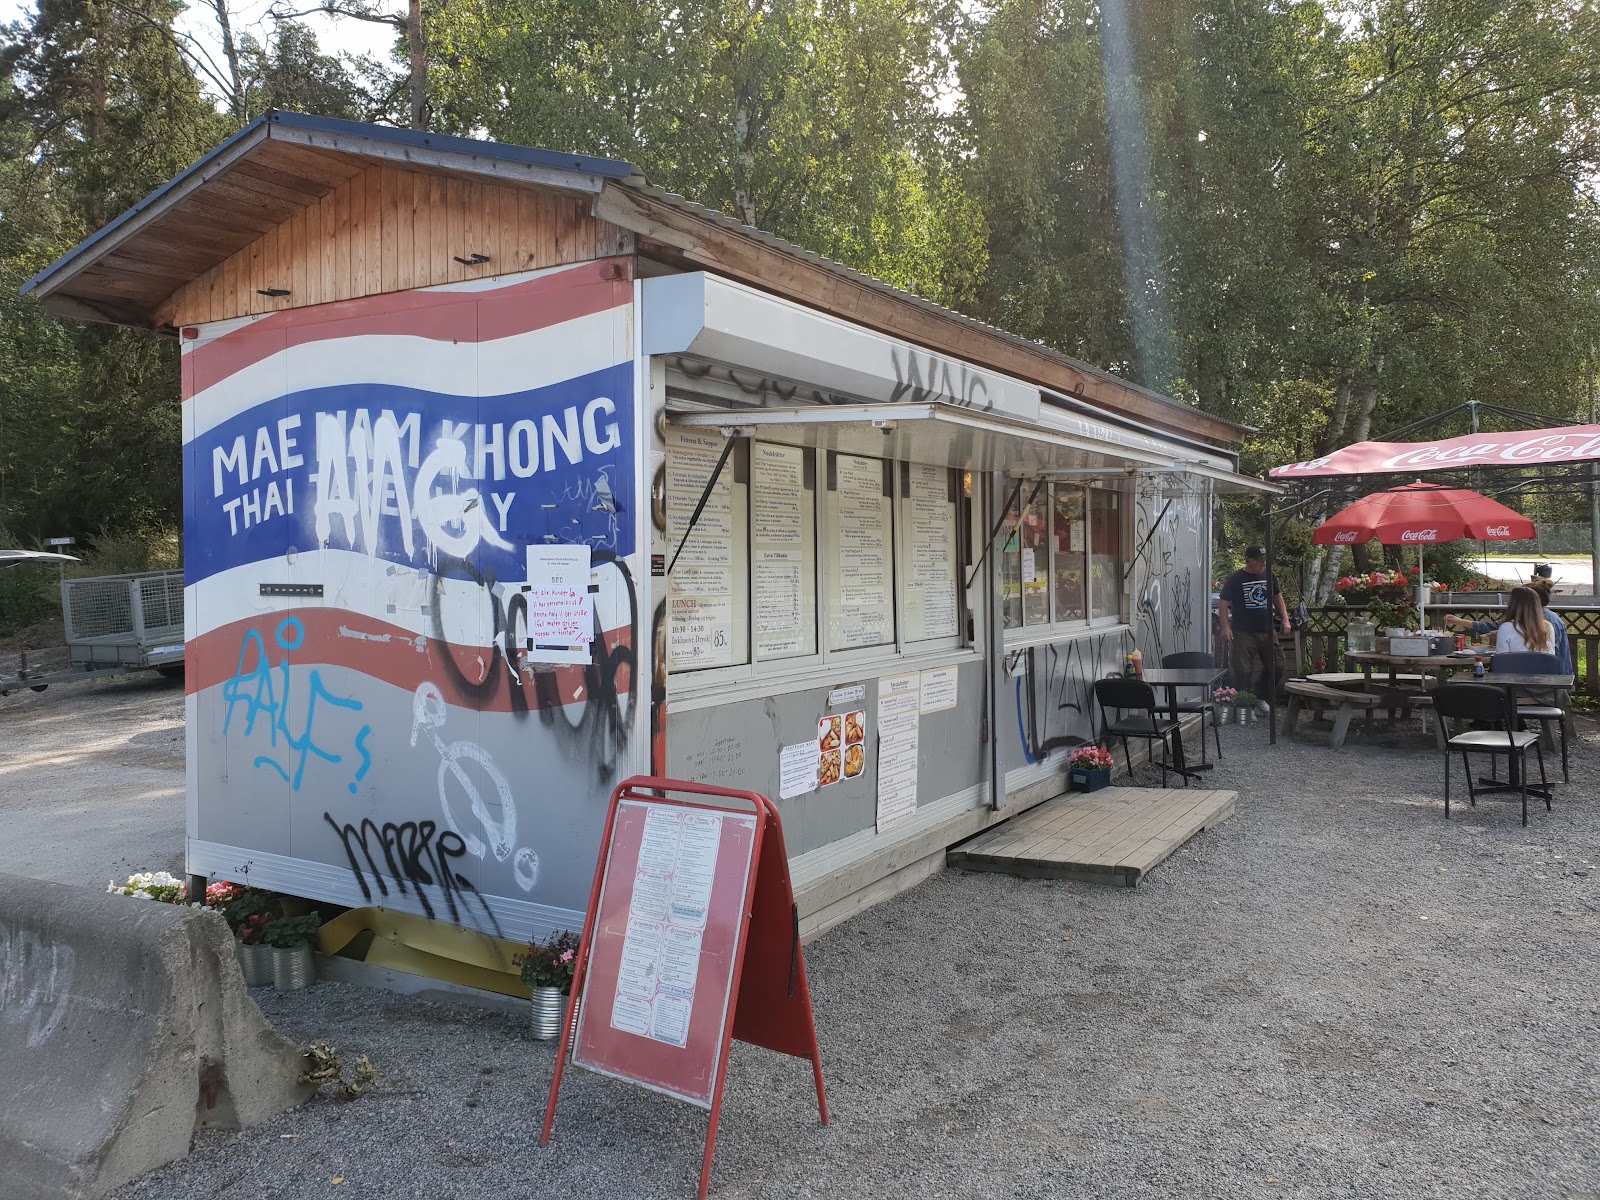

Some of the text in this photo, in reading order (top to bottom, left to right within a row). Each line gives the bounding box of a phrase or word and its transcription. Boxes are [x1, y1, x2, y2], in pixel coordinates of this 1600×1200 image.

[212, 413, 303, 498] MAE
[440, 397, 622, 481] KHONG
[223, 478, 294, 537] THAI
[1401, 529, 1439, 542] Coca-Cola
[1486, 525, 1511, 537] Coca-Cola
[671, 599, 697, 609] LUNCH
[672, 625, 686, 633] 10:30
[691, 624, 704, 632] 14:30
[713, 630, 724, 648] 85
